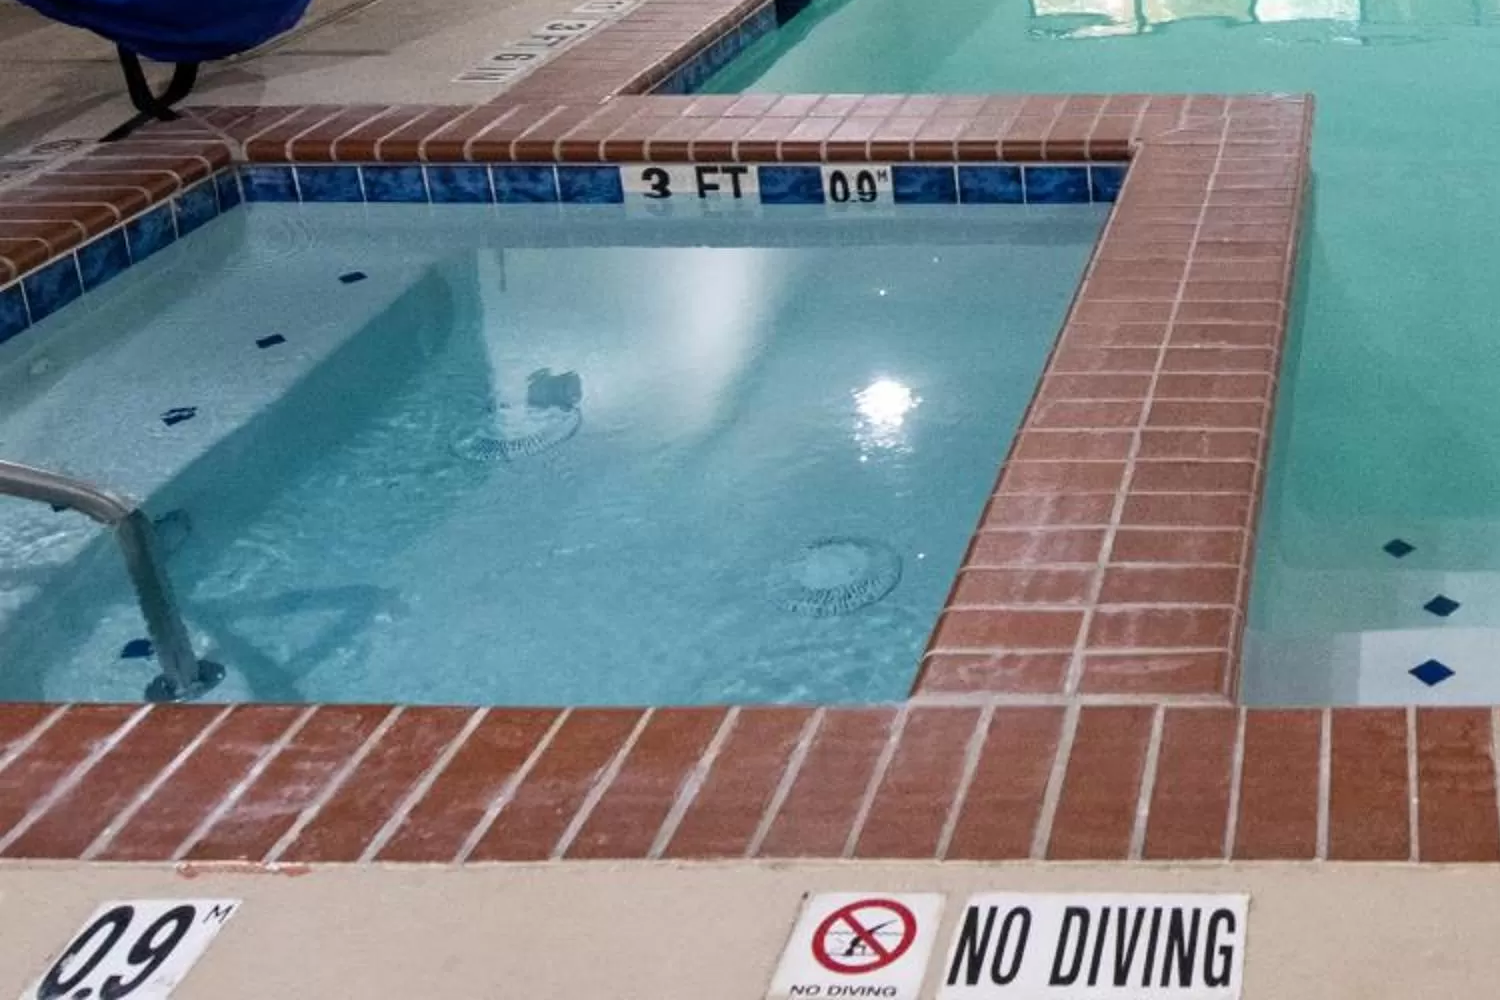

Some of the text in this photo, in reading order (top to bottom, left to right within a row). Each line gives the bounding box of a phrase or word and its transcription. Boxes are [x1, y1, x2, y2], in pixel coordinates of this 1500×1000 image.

[642, 166, 748, 198] 3 FT
[947, 905, 1237, 988] NO DIVING
[790, 984, 897, 998] NO DIVING
